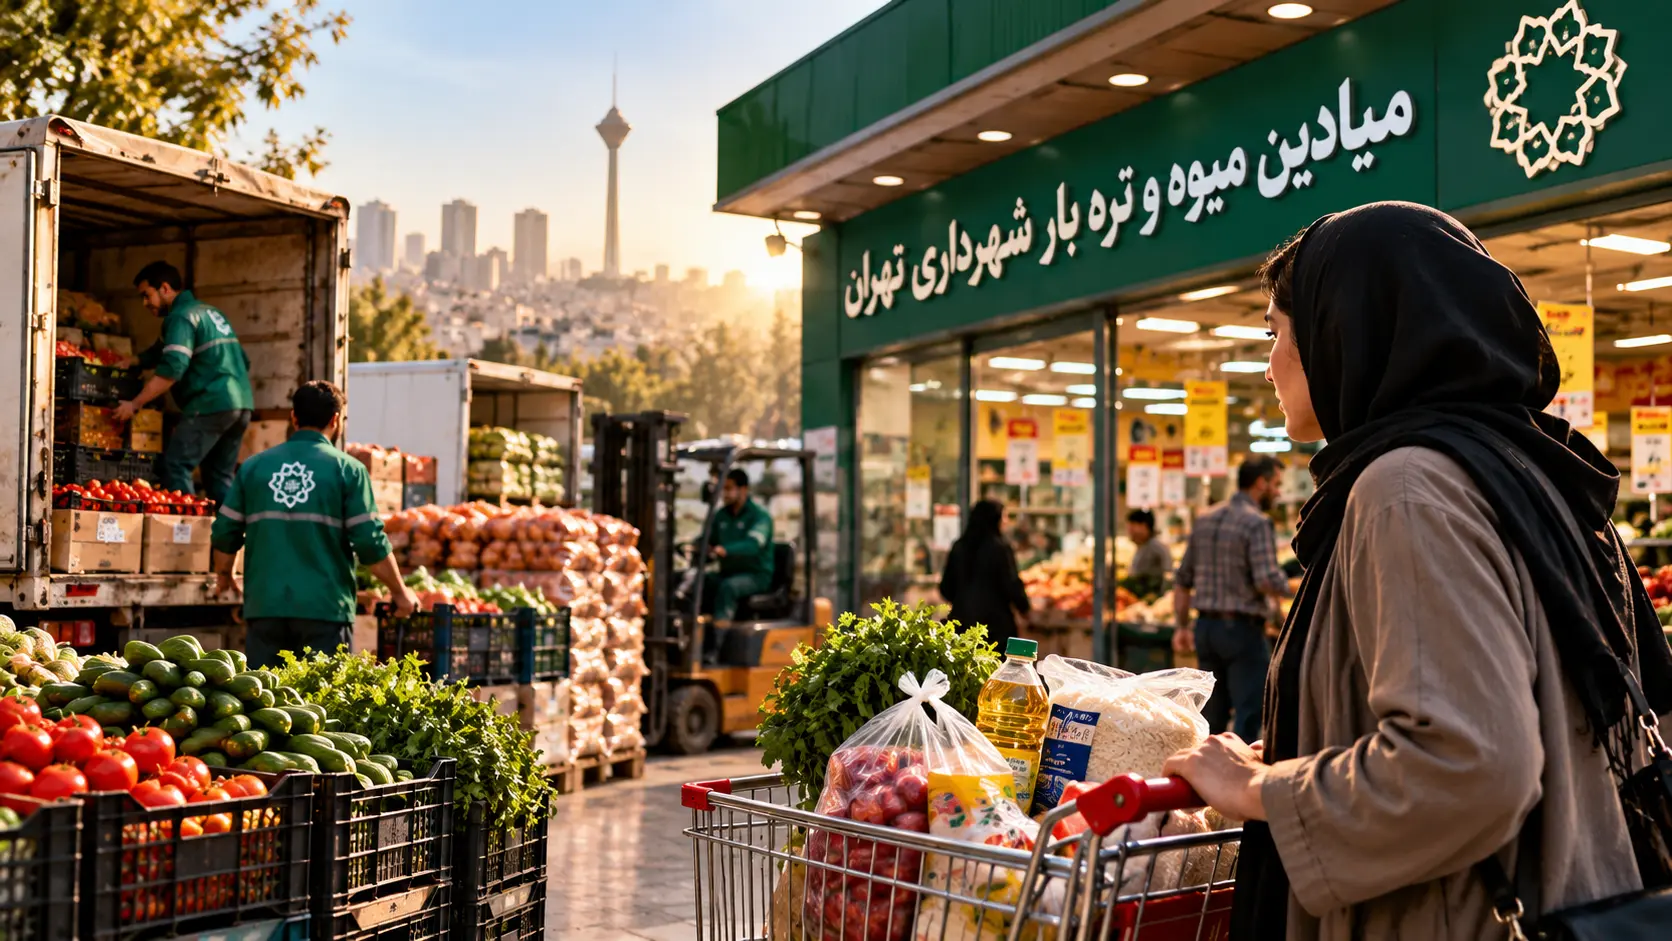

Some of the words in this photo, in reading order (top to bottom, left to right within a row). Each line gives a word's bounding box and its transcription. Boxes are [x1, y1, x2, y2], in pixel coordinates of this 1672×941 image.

[1257, 77, 1413, 198] میادین
[1038, 182, 1080, 265] بار
[1088, 165, 1134, 248] تره
[1139, 177, 1160, 236] و
[1167, 147, 1247, 222] میوه
[844, 244, 905, 318] تهران
[911, 197, 1032, 301] شهرداری
